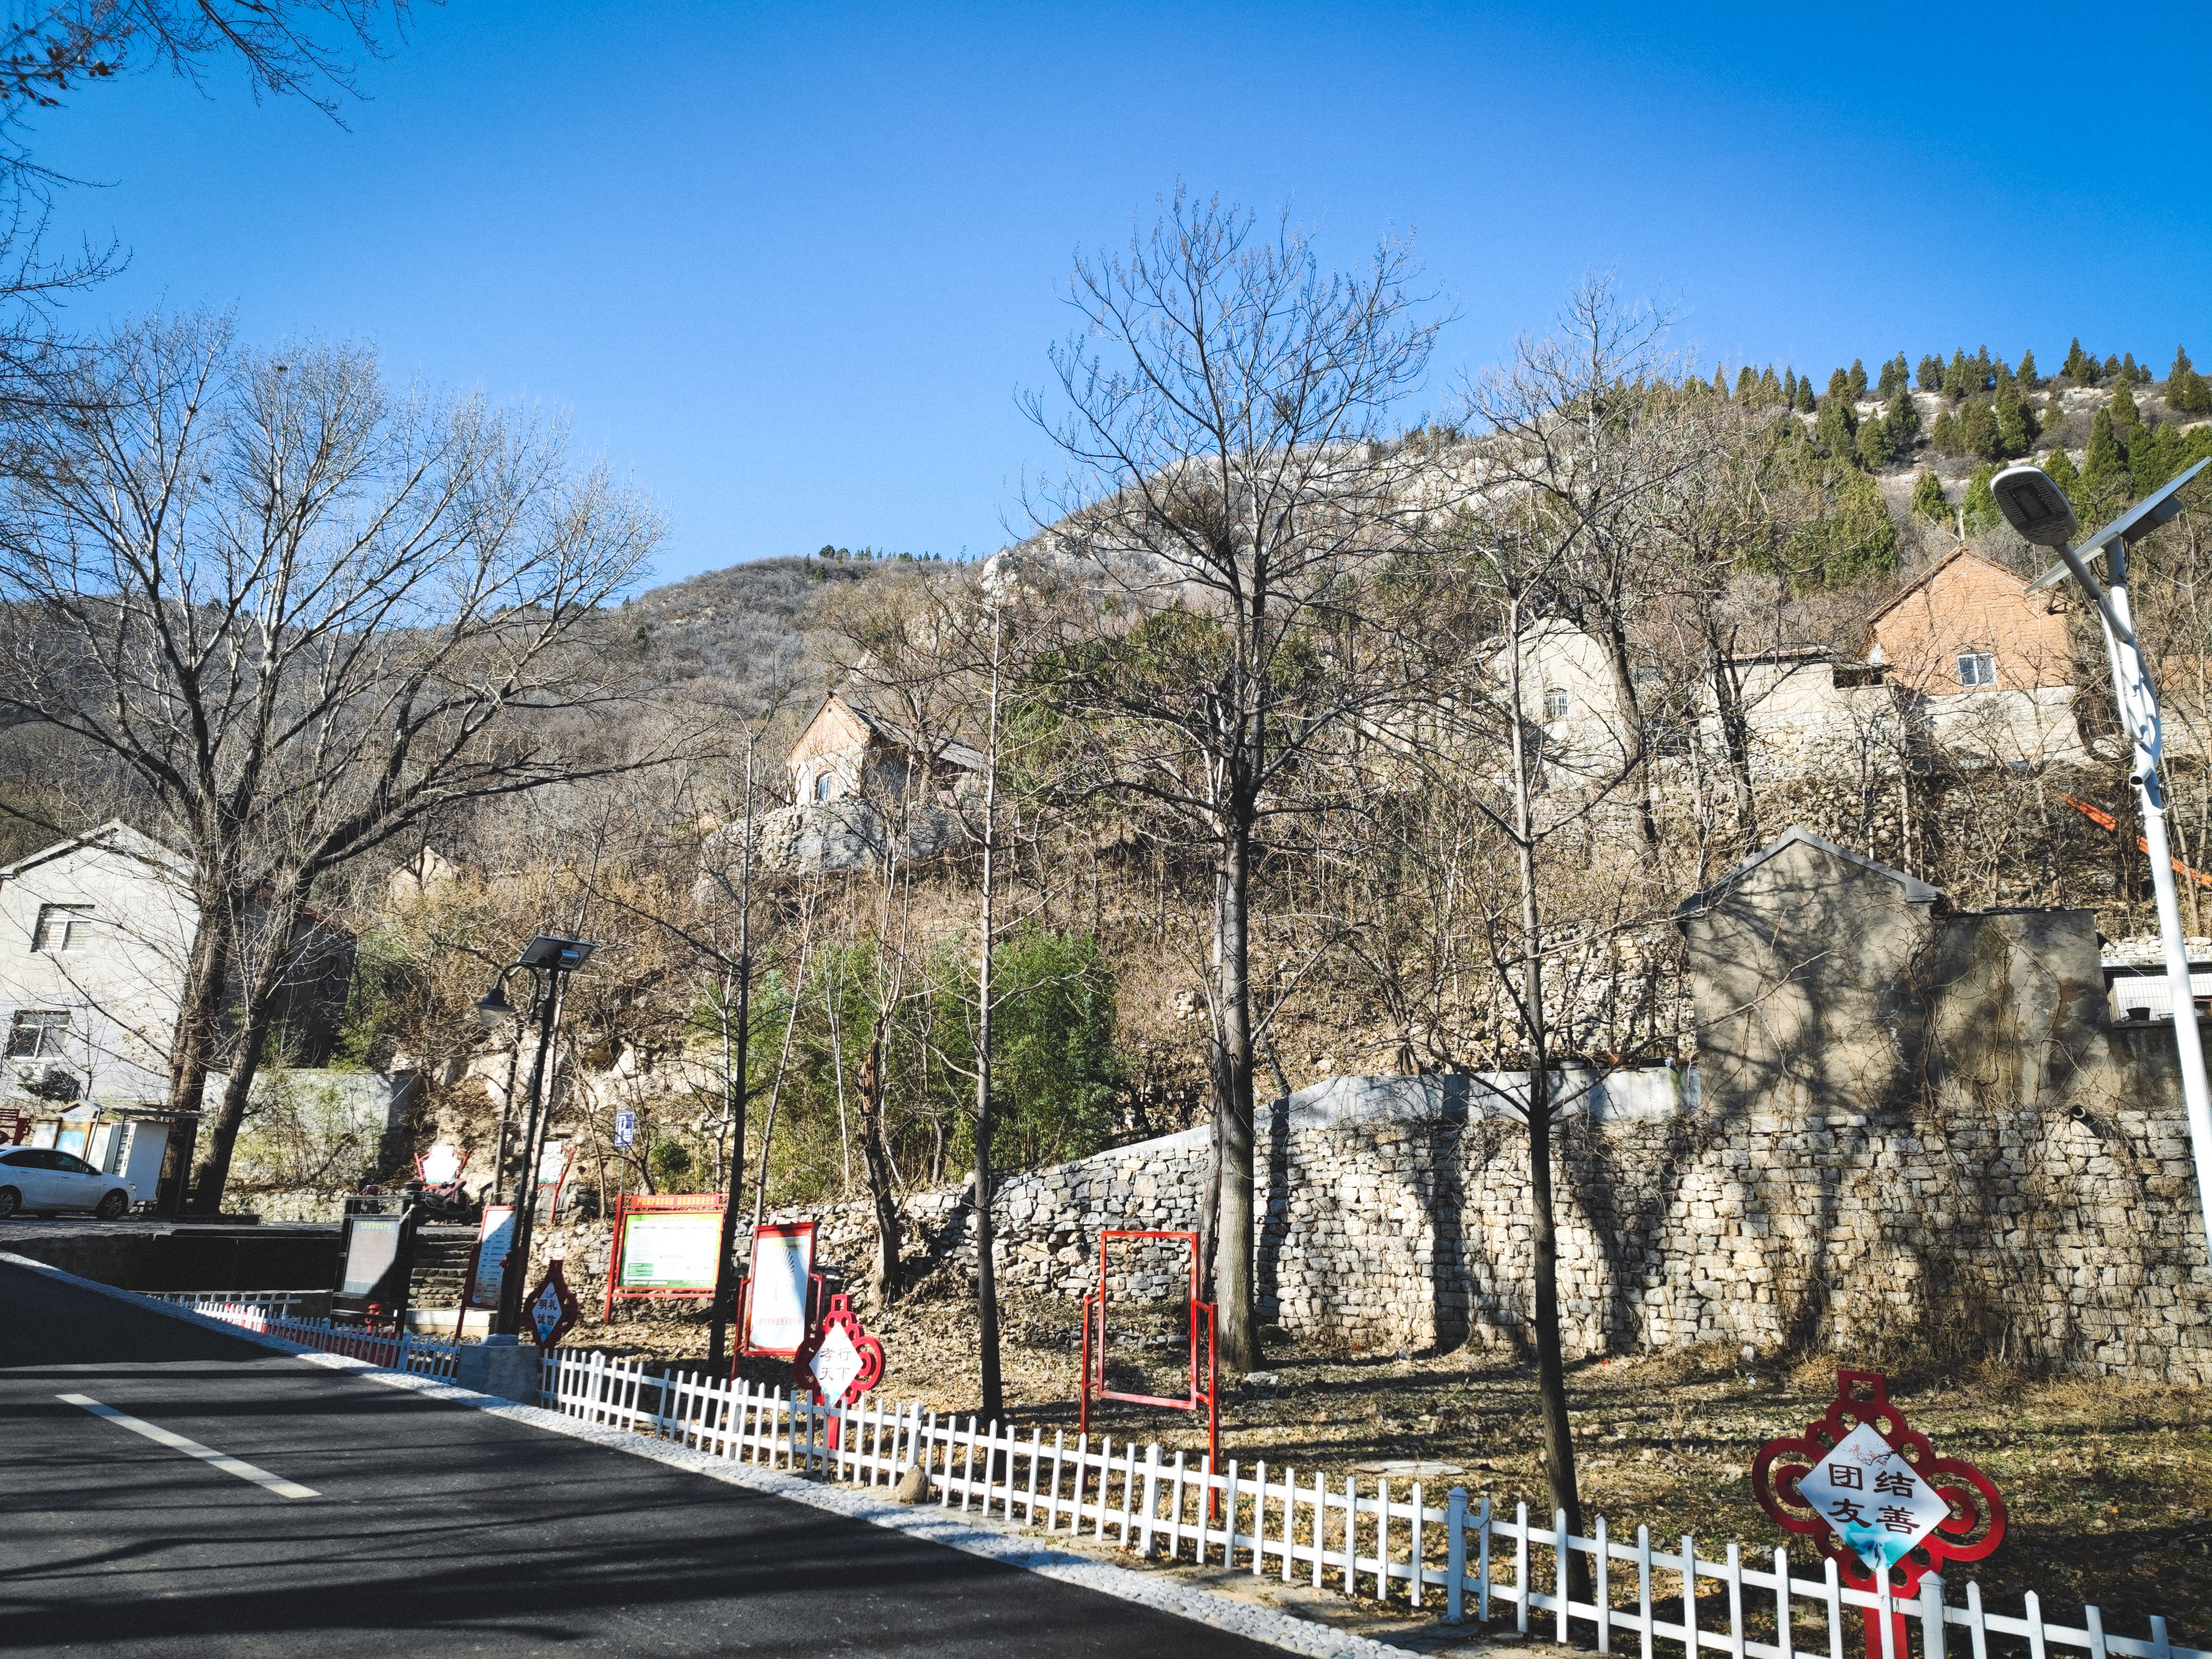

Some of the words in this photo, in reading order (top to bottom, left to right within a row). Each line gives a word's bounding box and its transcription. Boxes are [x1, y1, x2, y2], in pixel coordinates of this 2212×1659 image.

[539, 1300, 557, 1311] 明礼
[820, 1347, 852, 1362] 孝行
[819, 1367, 851, 1380] 天下
[1828, 1463, 1916, 1499] 团结
[1827, 1498, 1920, 1535] 友善
